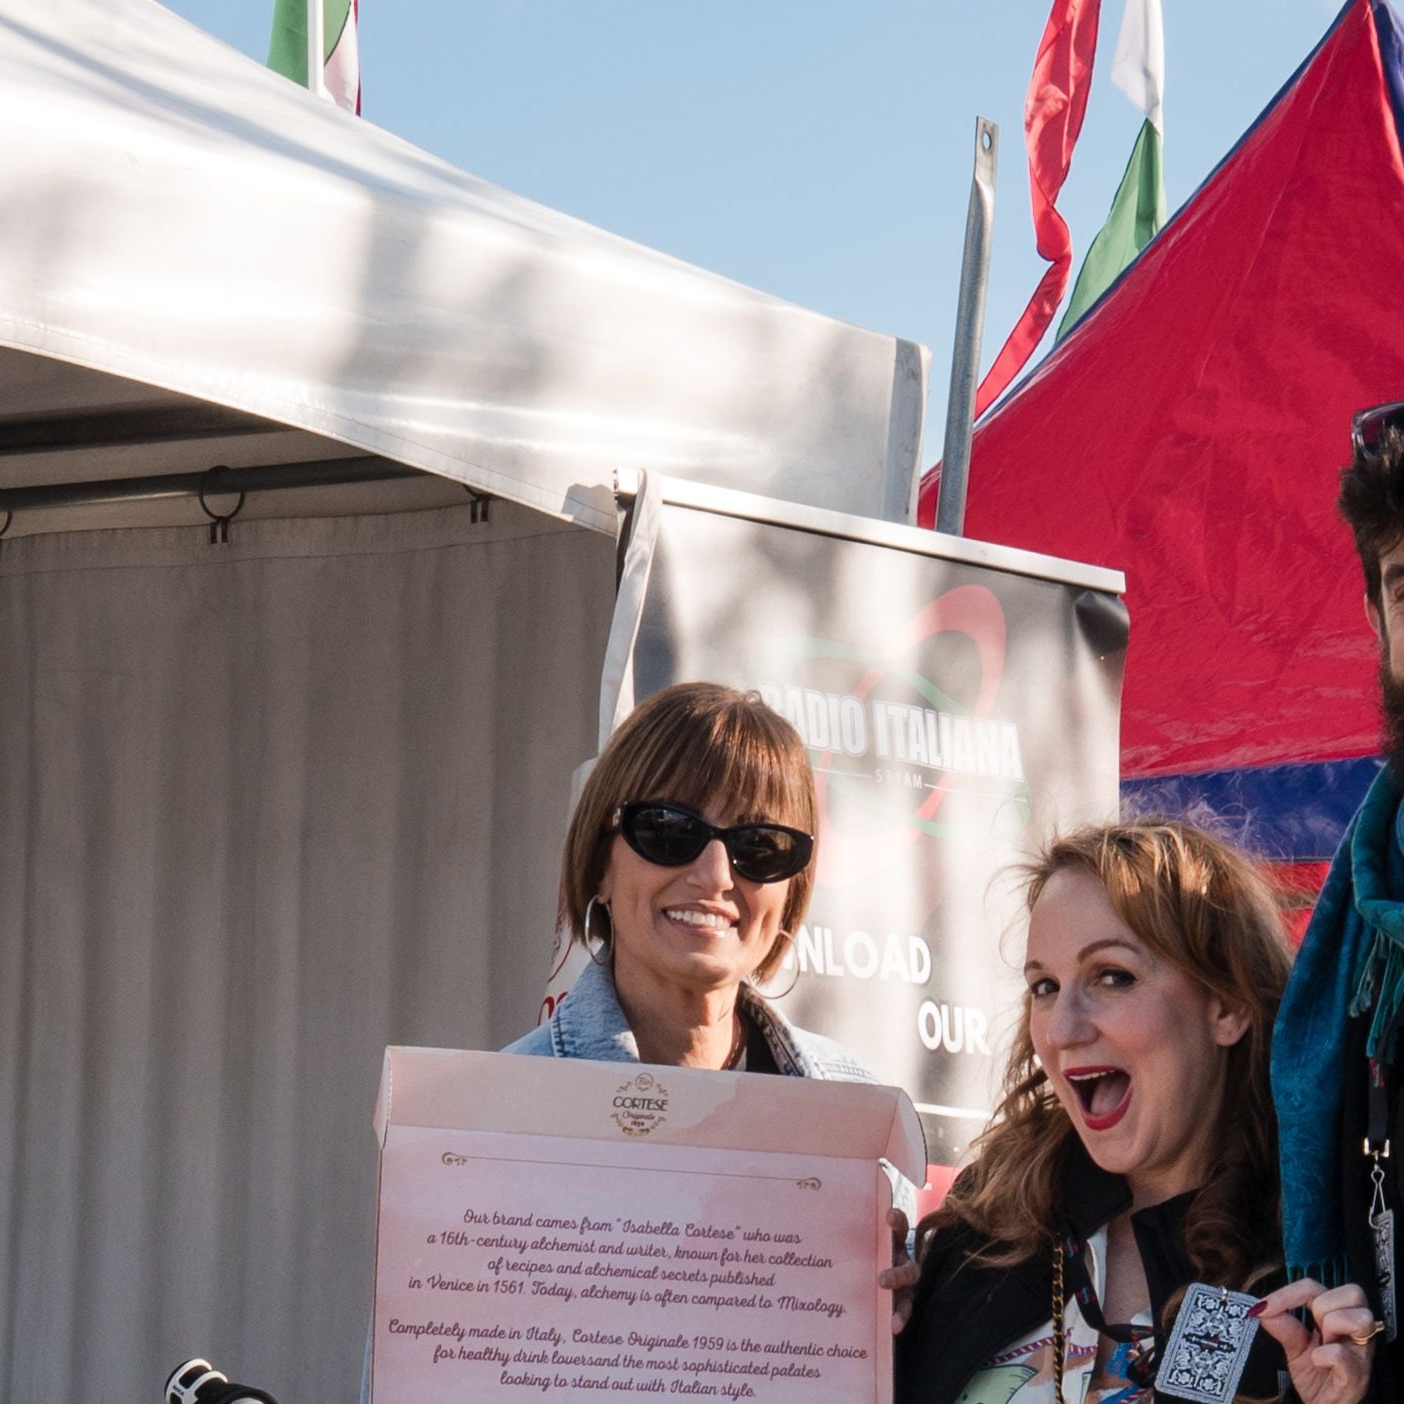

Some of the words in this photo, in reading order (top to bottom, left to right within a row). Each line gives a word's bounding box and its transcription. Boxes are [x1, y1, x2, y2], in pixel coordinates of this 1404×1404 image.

[872, 699, 1027, 783] ITALIANA
[783, 923, 932, 985] NLOAD
[917, 999, 993, 1057] OUR
[612, 1096, 669, 1112] CORTESE
[463, 1208, 491, 1225] Our
[492, 1210, 535, 1228] brand
[578, 1215, 613, 1236] from
[742, 1227, 771, 1243] who
[773, 1233, 804, 1245] was
[426, 1233, 438, 1245] a
[439, 1230, 530, 1256] 16th-century
[530, 1235, 597, 1254] alchemist
[597, 1240, 624, 1256] and
[673, 1244, 721, 1262] known
[719, 1247, 742, 1268] for
[742, 1248, 766, 1265] her
[767, 1251, 834, 1269] collection
[487, 1255, 505, 1277] of
[505, 1259, 554, 1278] recipes
[555, 1260, 584, 1276] and
[584, 1261, 659, 1281] alchemical
[660, 1267, 709, 1285] secrets
[709, 1269, 776, 1289] published
[408, 1275, 423, 1290] in
[426, 1272, 475, 1293] Venice
[476, 1279, 491, 1294] in
[580, 1283, 638, 1307] alchemy
[639, 1288, 652, 1303] is
[653, 1287, 689, 1309] often
[690, 1293, 758, 1312] compared
[757, 1293, 774, 1310] to
[387, 1317, 467, 1343] Completely
[467, 1323, 507, 1340] made
[507, 1326, 523, 1341] in
[571, 1327, 625, 1346] Cortese
[626, 1330, 690, 1353] Originale
[691, 1335, 724, 1351] 1959
[725, 1338, 739, 1352] is
[739, 1337, 763, 1354] the
[762, 1339, 826, 1357] authentic
[825, 1343, 869, 1360] choice
[432, 1343, 456, 1365] for
[457, 1344, 512, 1368] healthy
[512, 1347, 550, 1365] drink
[622, 1353, 645, 1370] the
[645, 1356, 681, 1372] most
[681, 1357, 770, 1382] sophisticated
[769, 1361, 822, 1382] palates
[499, 1369, 551, 1393] looking
[552, 1372, 569, 1389] to
[570, 1374, 610, 1391] stand
[610, 1376, 635, 1392] out
[635, 1377, 667, 1393] with
[669, 1378, 718, 1396] Italian
